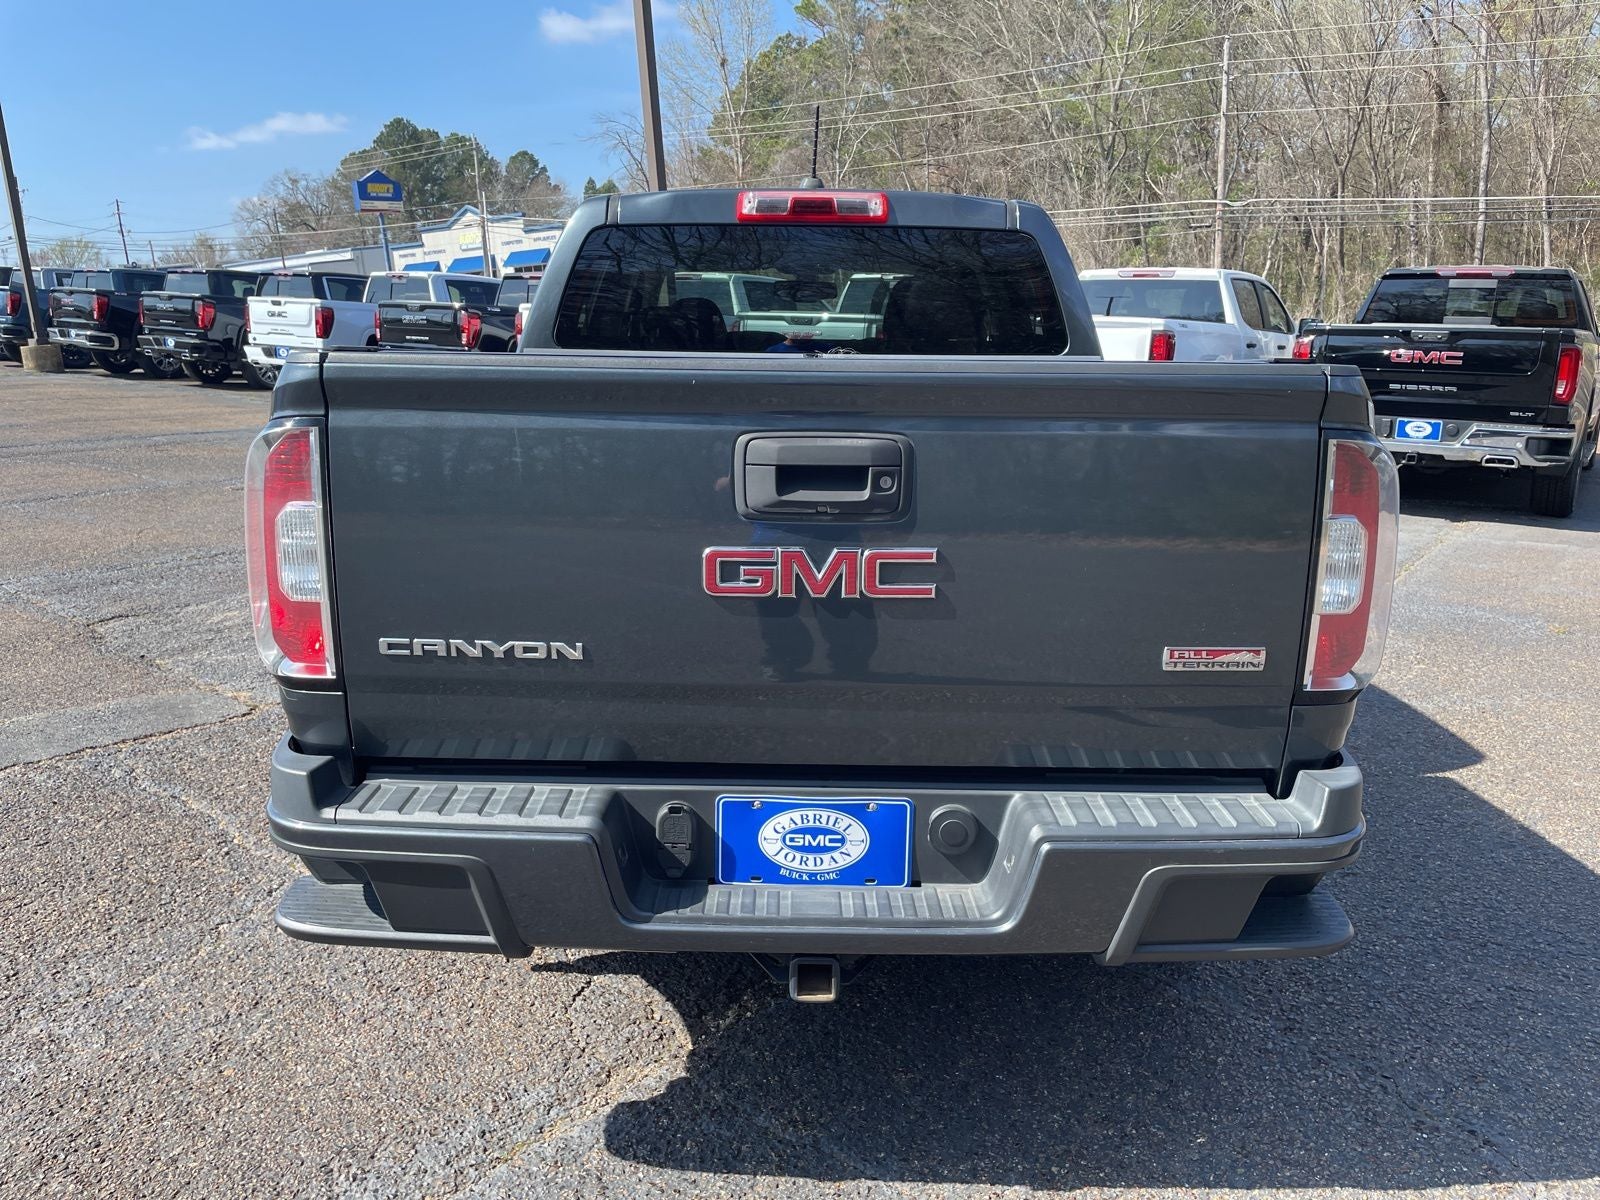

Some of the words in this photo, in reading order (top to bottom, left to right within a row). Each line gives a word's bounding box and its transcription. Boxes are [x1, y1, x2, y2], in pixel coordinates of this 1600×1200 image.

[1390, 349, 1464, 365] GMC
[1388, 383, 1458, 392] SIERRA
[702, 546, 938, 599] GMC
[378, 637, 584, 661] CANYON
[1174, 650, 1214, 658] ALL
[773, 813, 852, 836] GABRIEL
[785, 834, 843, 847] GMC
[772, 847, 853, 867] JORDAN
[779, 867, 810, 881] BUICK
[817, 871, 841, 881] GMC
